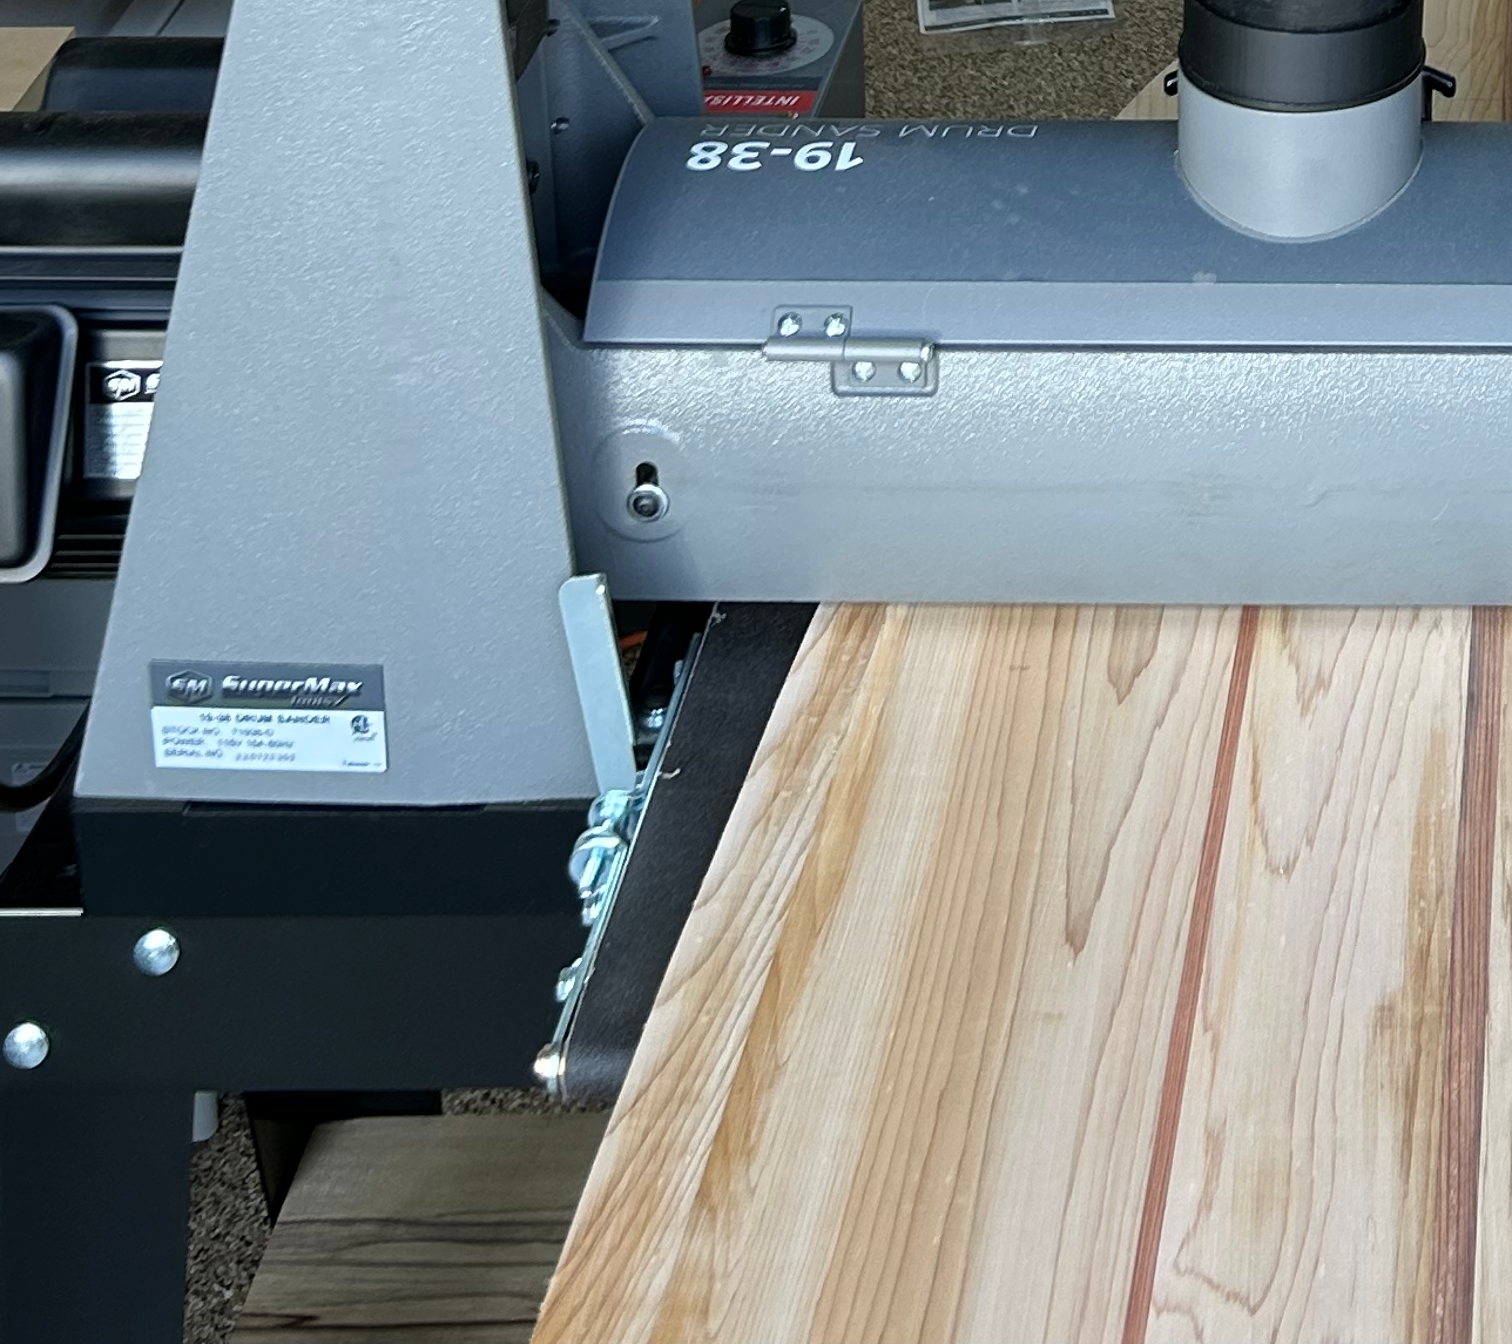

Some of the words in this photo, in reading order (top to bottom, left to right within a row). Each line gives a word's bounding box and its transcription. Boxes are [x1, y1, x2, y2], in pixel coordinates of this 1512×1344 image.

[701, 124, 881, 138] SANDER
[898, 125, 1038, 139] DRUM
[687, 141, 864, 172] 19-38
